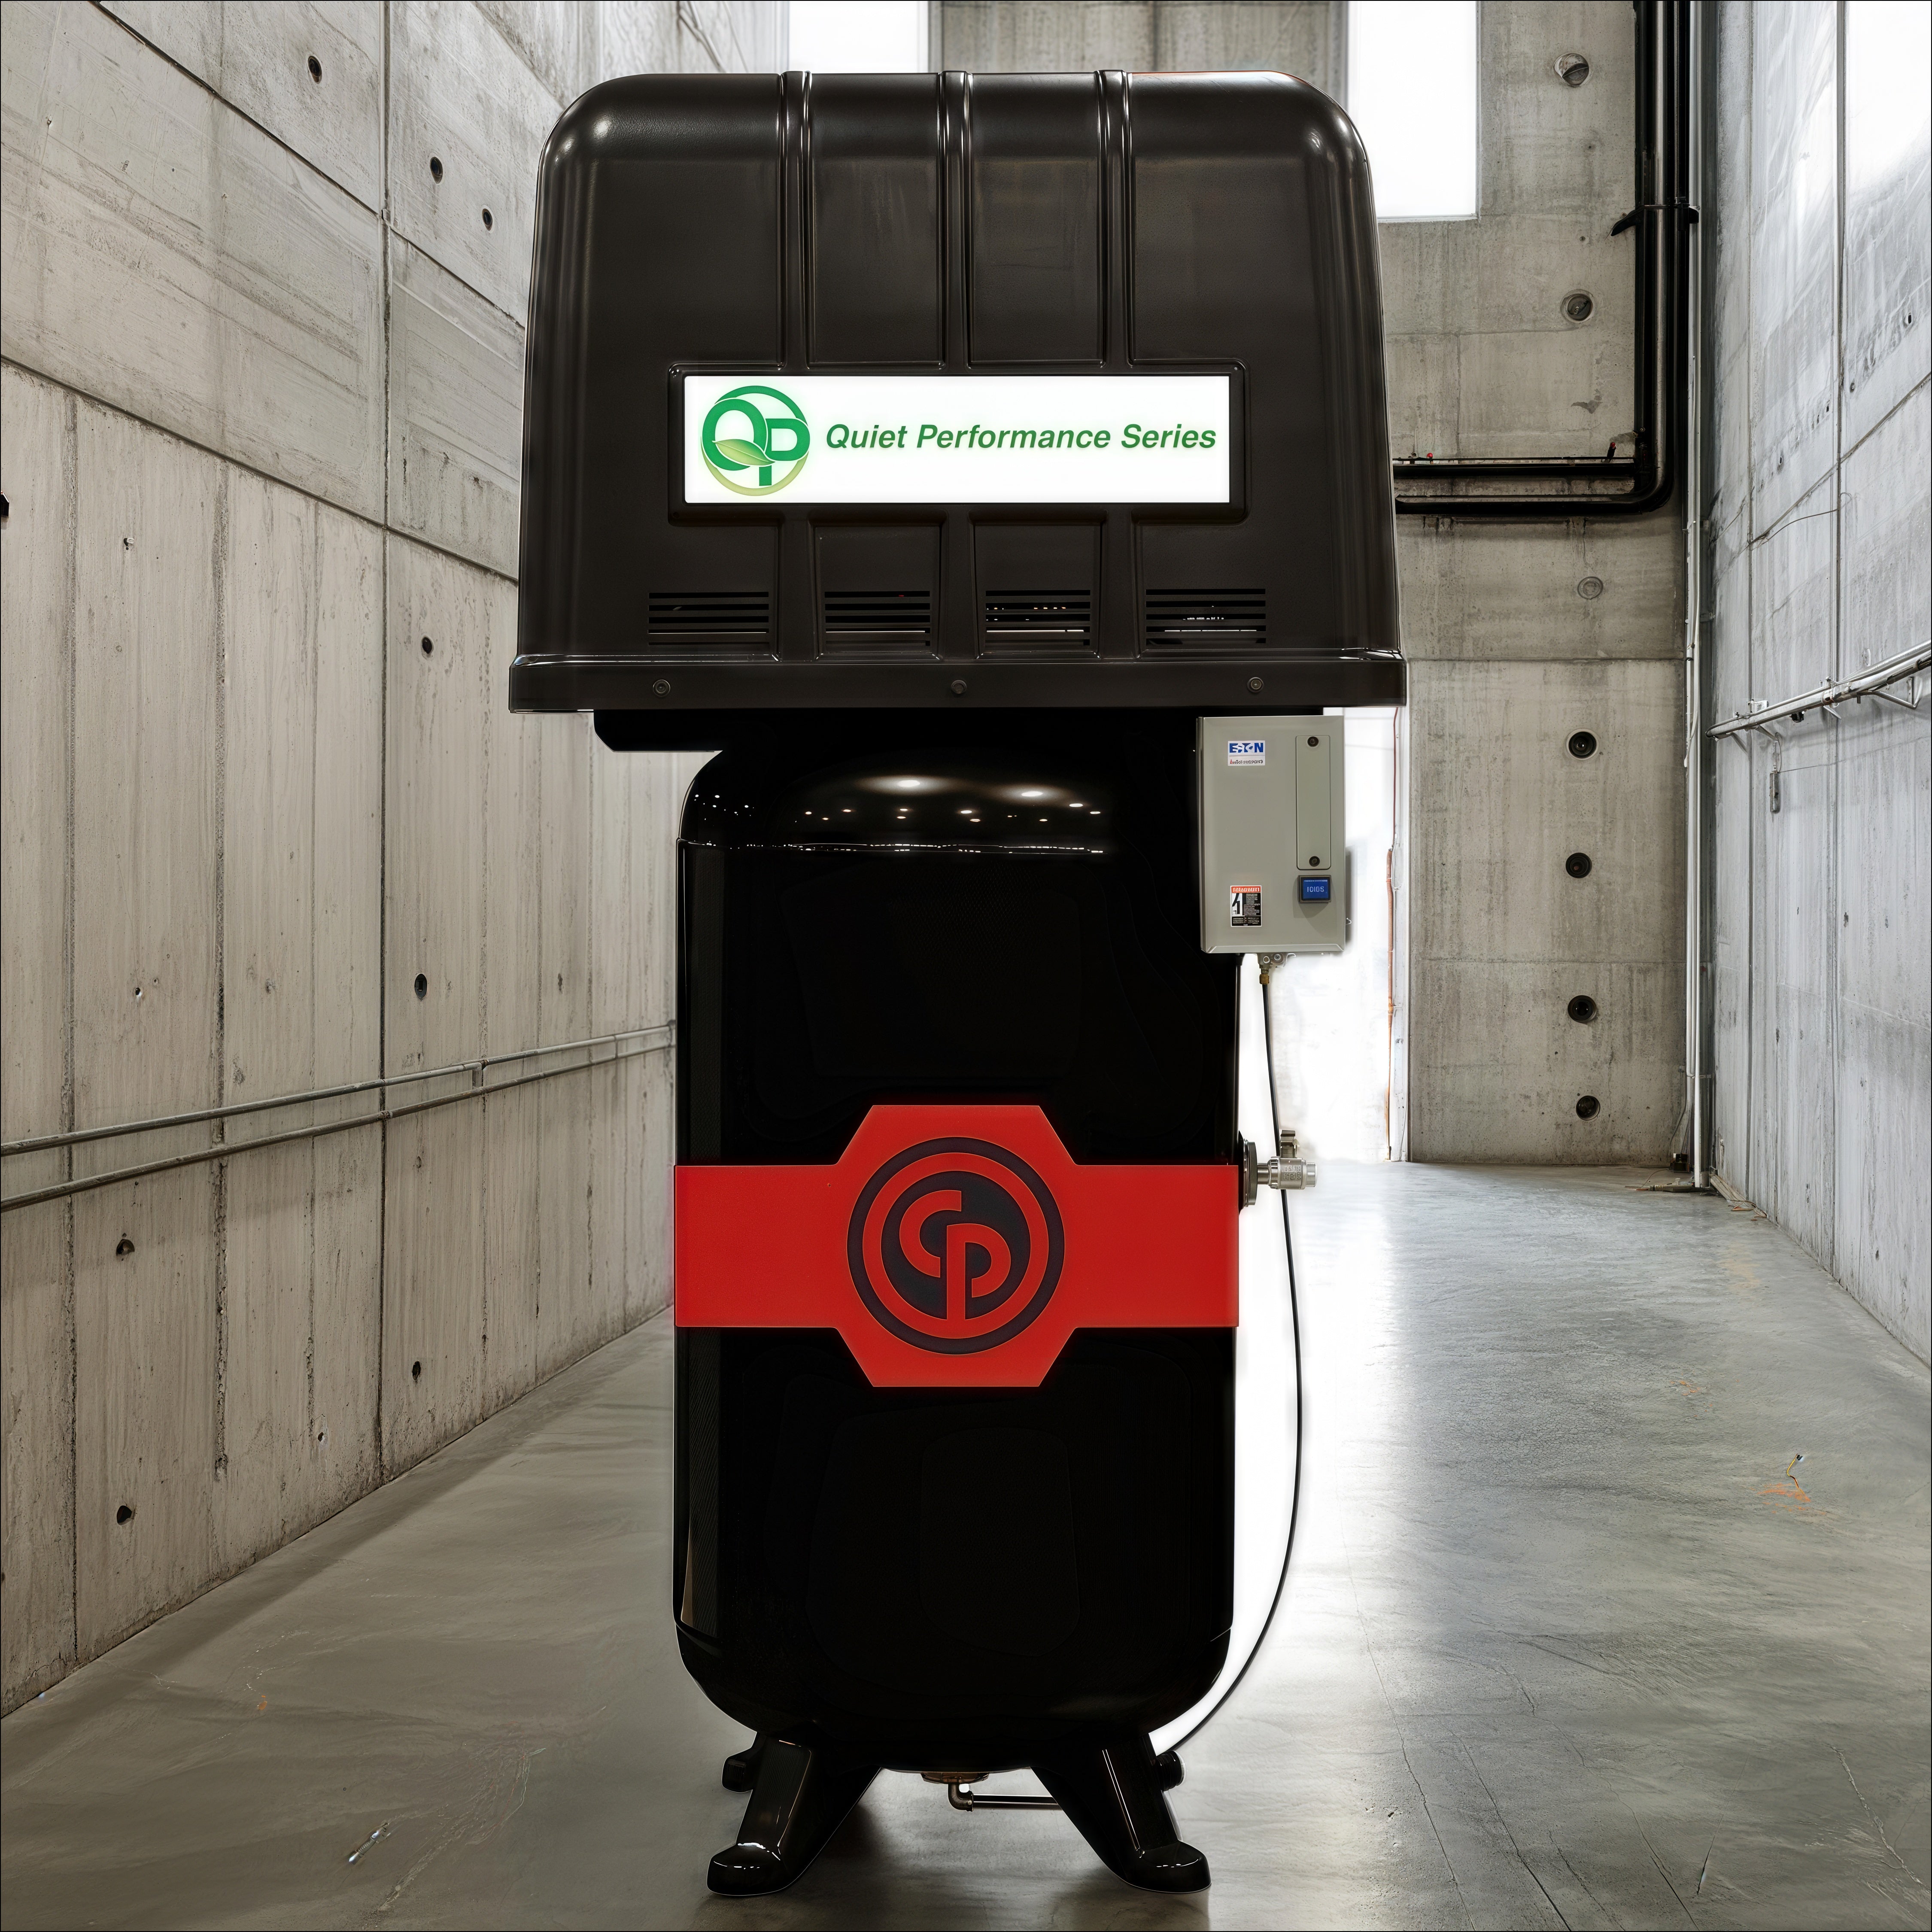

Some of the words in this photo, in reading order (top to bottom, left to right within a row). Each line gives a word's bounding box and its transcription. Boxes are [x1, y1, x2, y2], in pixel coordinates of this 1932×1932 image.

[826, 424, 907, 448] Quiet
[917, 425, 1110, 448] Performance
[1122, 424, 1215, 448] Series
[899, 1189, 1011, 1320] CP
